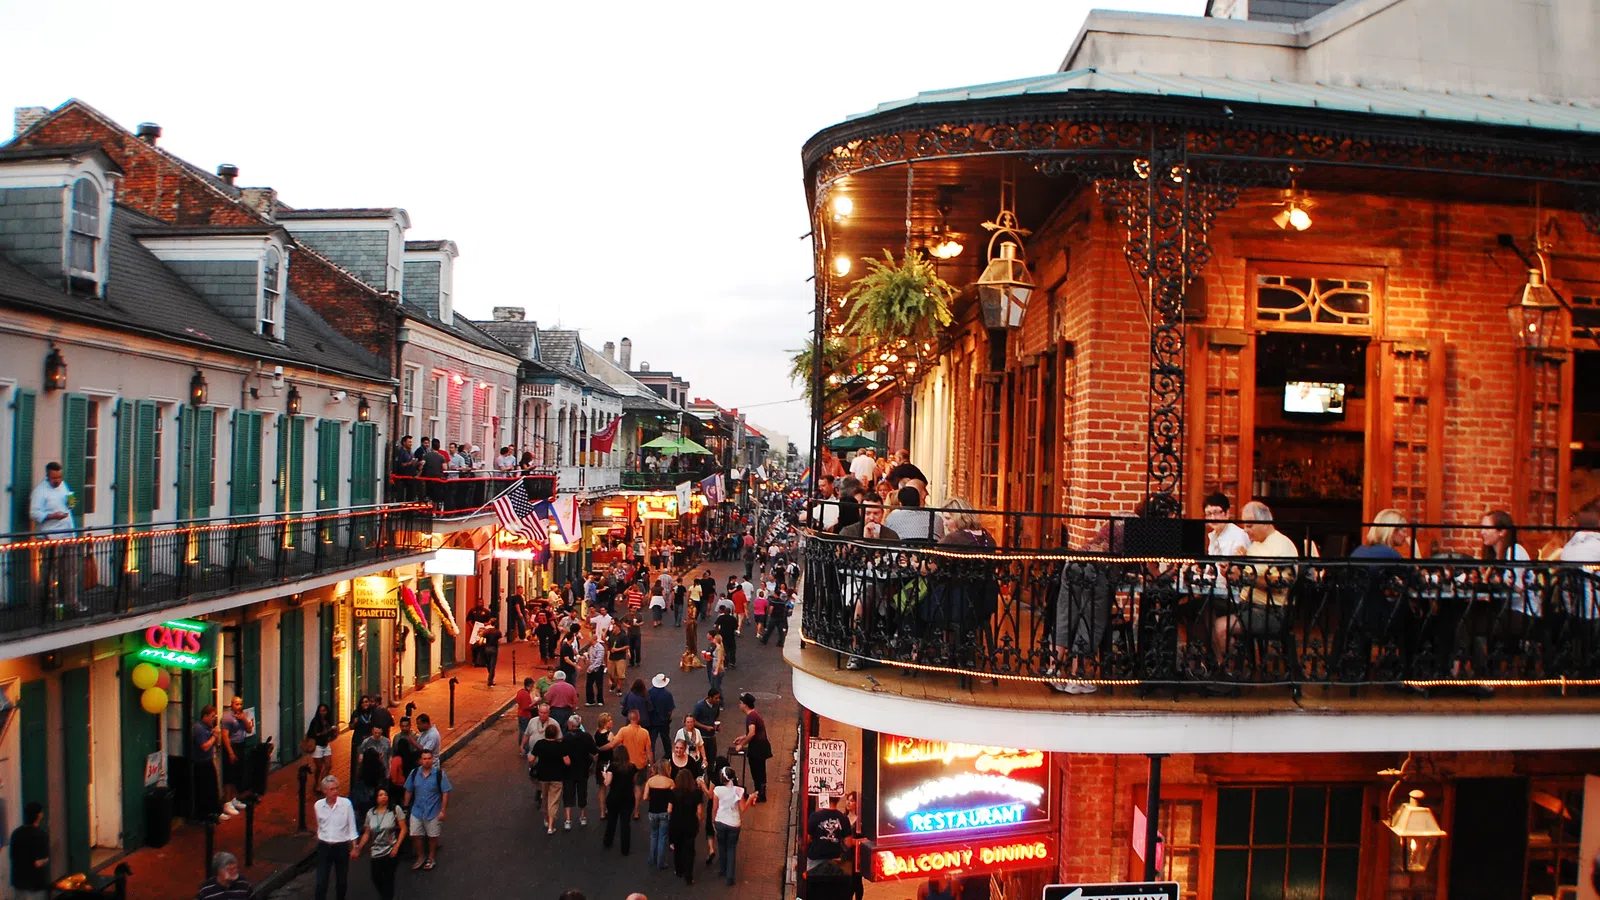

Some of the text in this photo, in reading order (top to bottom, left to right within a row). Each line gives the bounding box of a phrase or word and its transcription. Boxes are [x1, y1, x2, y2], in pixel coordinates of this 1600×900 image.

[355, 609, 396, 617] CIGARETTES
[810, 758, 839, 766] SERVICE
[809, 767, 842, 775] EHICLS
[910, 805, 1025, 831] RESTAURANT
[980, 843, 1047, 864] DINING
